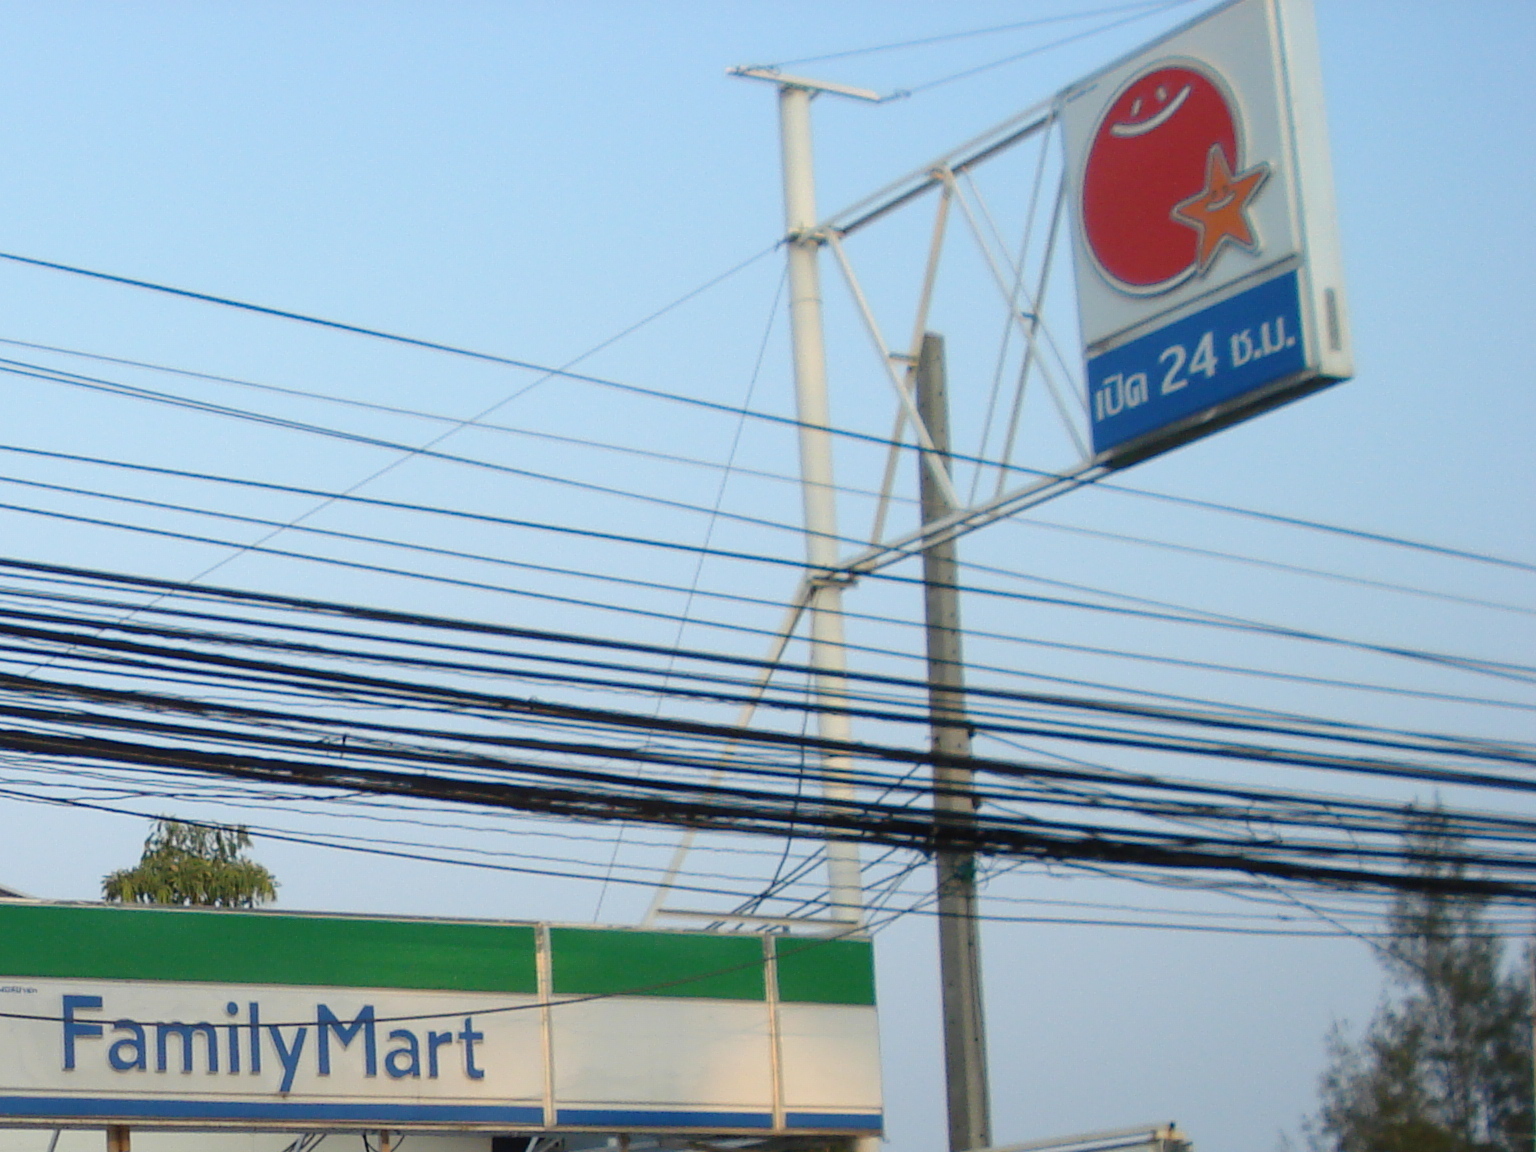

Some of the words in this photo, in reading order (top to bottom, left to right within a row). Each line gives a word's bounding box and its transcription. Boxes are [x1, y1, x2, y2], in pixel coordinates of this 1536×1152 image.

[1094, 371, 1150, 423] เปิด
[1159, 331, 1219, 397] 24
[62, 994, 486, 1093] FamilyMart
